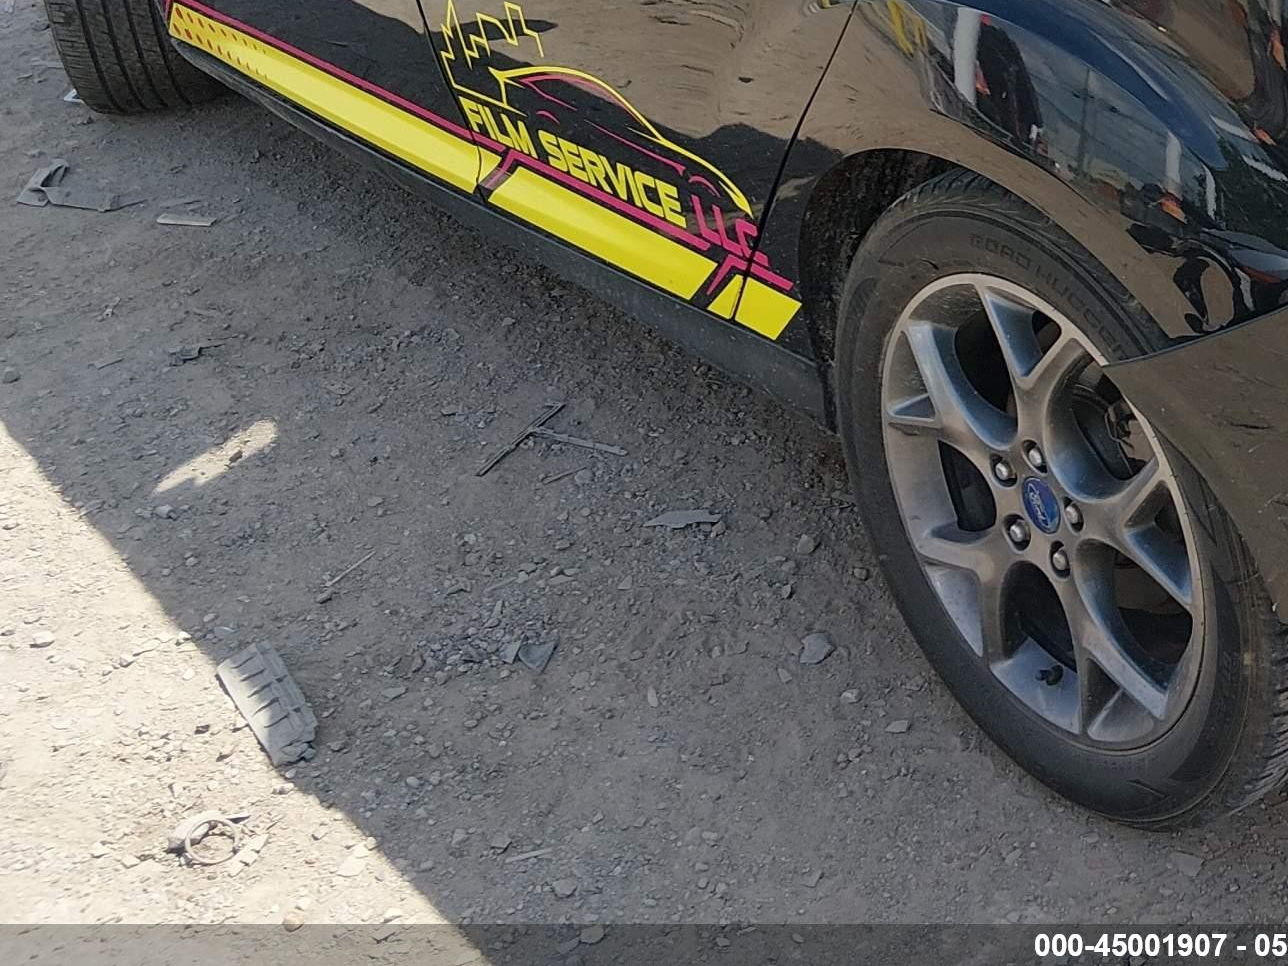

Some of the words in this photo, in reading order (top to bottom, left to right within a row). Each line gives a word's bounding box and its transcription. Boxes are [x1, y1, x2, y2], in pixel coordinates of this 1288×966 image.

[458, 95, 538, 159] FILM
[537, 129, 687, 229] SERVICE
[691, 194, 769, 267] LLC
